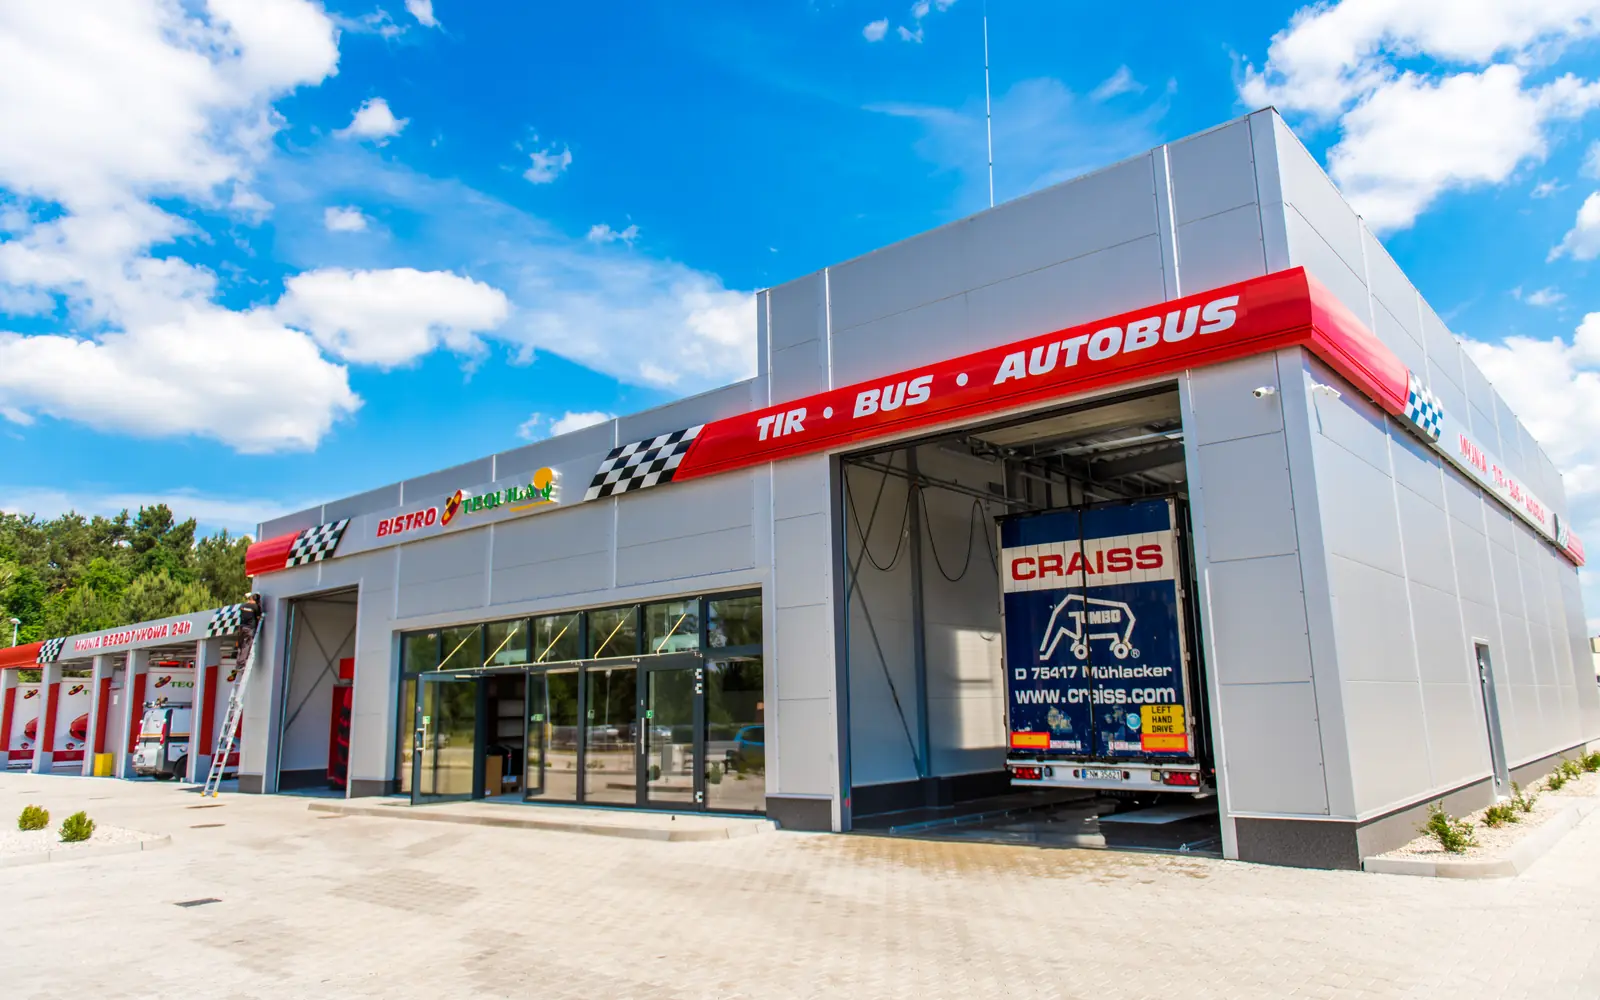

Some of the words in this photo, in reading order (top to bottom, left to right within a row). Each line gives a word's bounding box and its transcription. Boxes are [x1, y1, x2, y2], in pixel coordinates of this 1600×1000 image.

[757, 407, 807, 441] TIR
[853, 375, 934, 419] BUS
[993, 296, 1239, 386] AUTOBUS
[376, 507, 436, 537] BISTRO
[462, 483, 536, 514] TEQUILA
[1011, 544, 1163, 580] CRAISS
[102, 624, 169, 646] BEZDOTYKOWA
[171, 620, 193, 637] 24h
[1015, 667, 1027, 680] D
[1031, 666, 1077, 680] 75417
[1082, 664, 1173, 679] Mühlacker
[1015, 684, 1176, 704] www.craiss.com
[1151, 706, 1171, 714] LEFT
[1152, 716, 1172, 724] HAND
[1152, 725, 1174, 733] DRIVE
